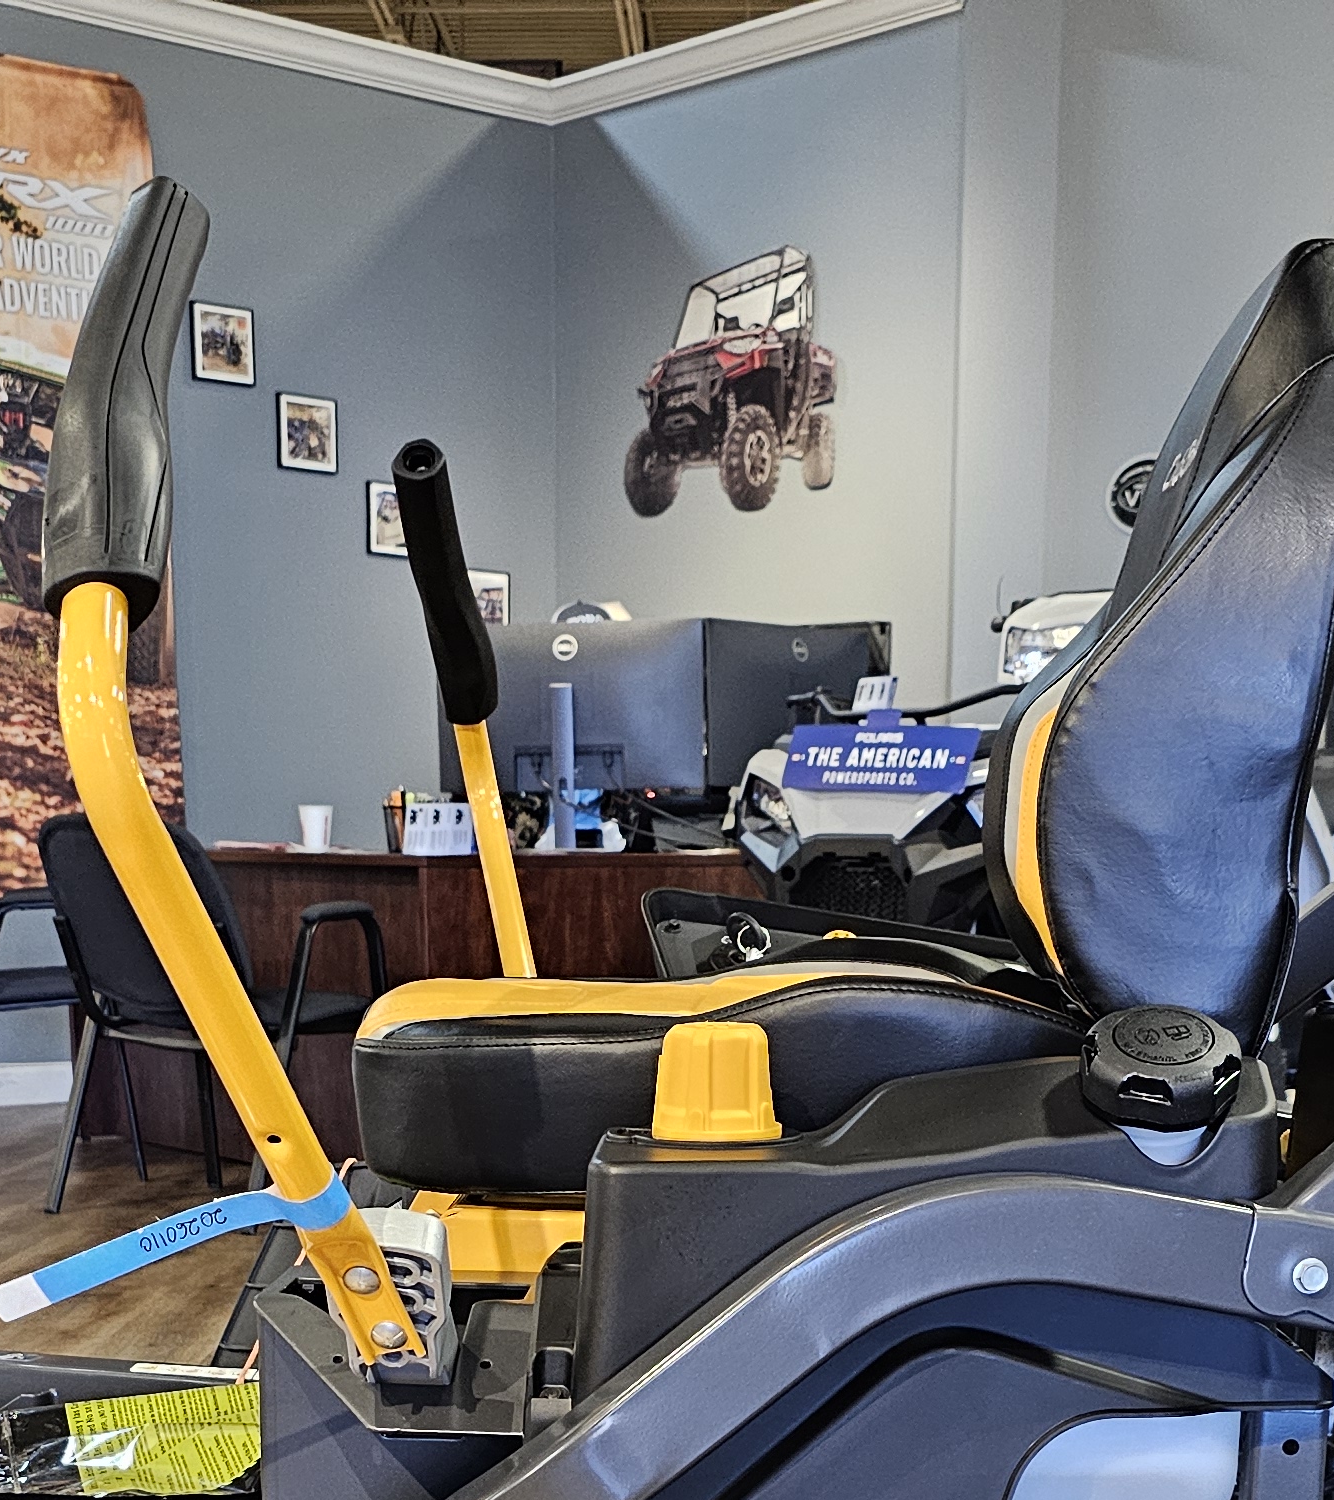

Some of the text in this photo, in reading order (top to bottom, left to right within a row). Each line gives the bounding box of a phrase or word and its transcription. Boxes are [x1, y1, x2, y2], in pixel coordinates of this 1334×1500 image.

[45, 215, 115, 238] 1000
[11, 236, 101, 281] WORLD
[807, 746, 950, 769] THE AMERICAN
[822, 770, 917, 786] POWERSPORTS CO.
